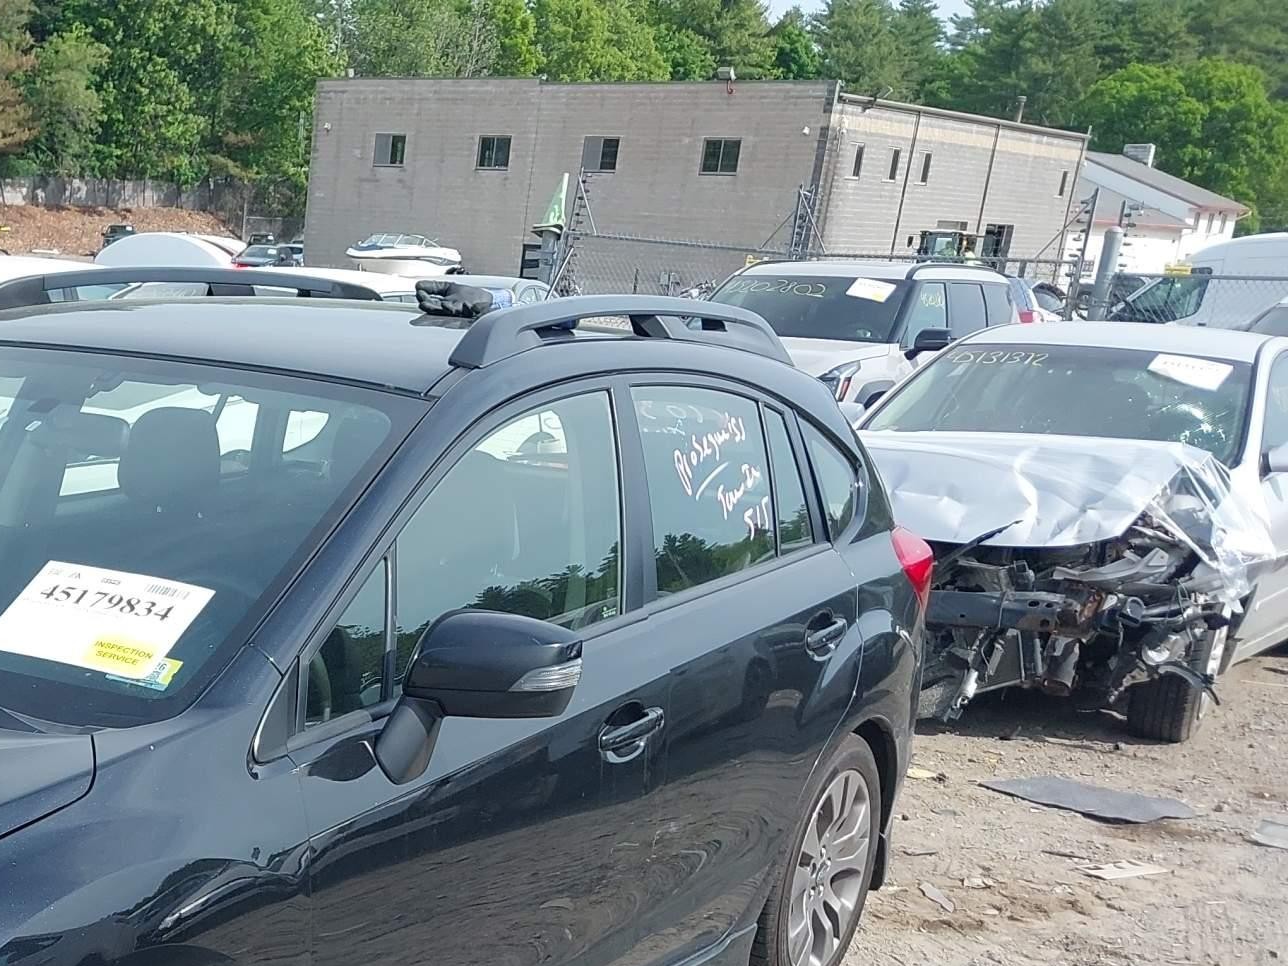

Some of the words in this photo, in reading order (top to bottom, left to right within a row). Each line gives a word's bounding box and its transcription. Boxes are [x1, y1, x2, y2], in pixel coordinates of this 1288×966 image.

[40, 584, 175, 621] 45179834
[94, 640, 153, 660] INSPECTION
[95, 650, 140, 666] SERVICE
